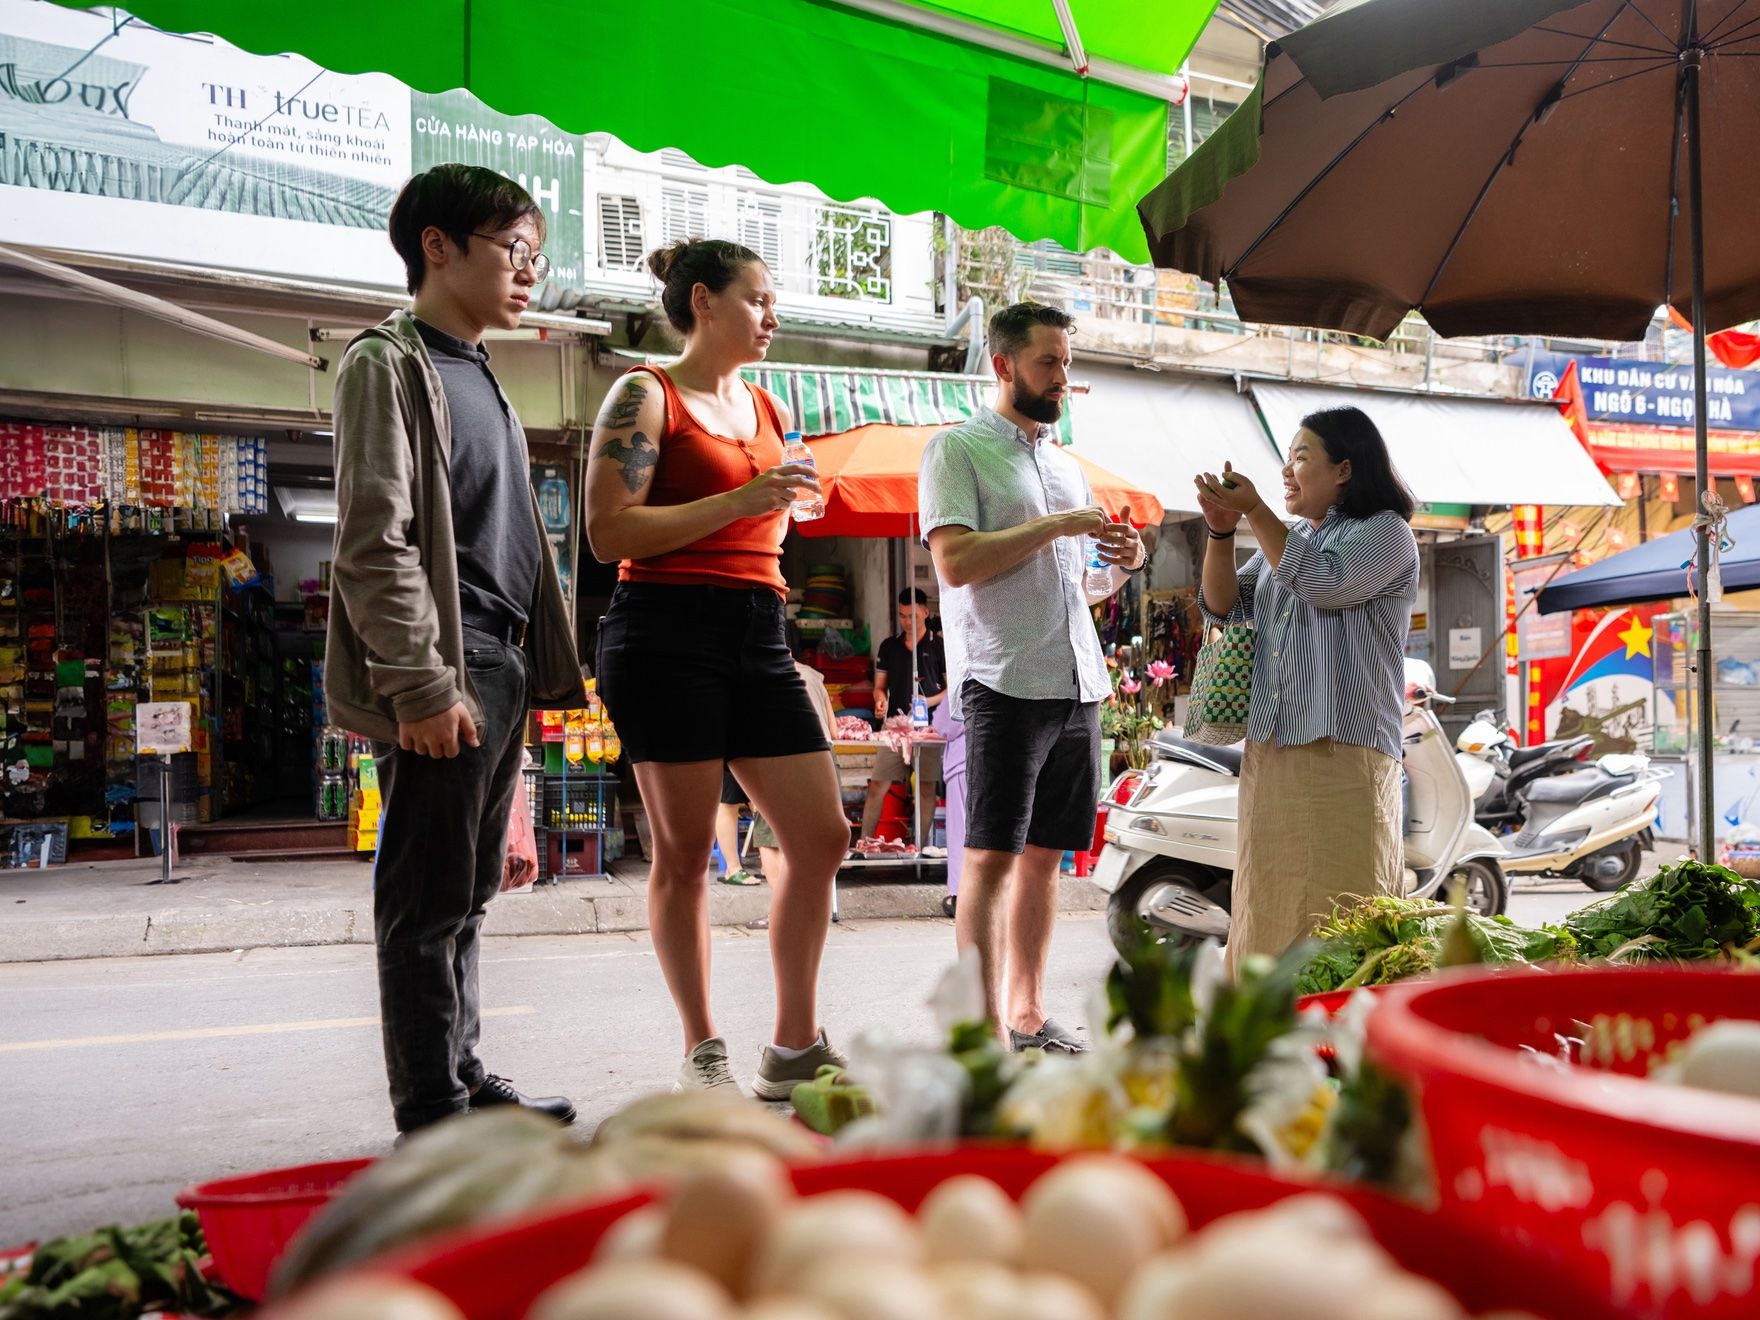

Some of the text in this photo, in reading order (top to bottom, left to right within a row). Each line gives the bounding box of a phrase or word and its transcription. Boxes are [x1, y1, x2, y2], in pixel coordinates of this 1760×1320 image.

[202, 82, 247, 110] TH
[208, 128, 392, 166] hoàn toàn từ thiên nhiên
[214, 113, 263, 132] Thanh
[346, 136, 386, 151] khoái
[416, 115, 575, 157] CỬA HÀNG TẠP HÓA
[1581, 366, 1615, 385] KHU
[1617, 368, 1651, 388] DÂN
[1653, 372, 1678, 390] CƯ
[1713, 375, 1745, 395] HÓA
[1634, 395, 1647, 415] 6
[1657, 396, 1695, 422] NGỌ
[1709, 396, 1732, 421] HÀ
